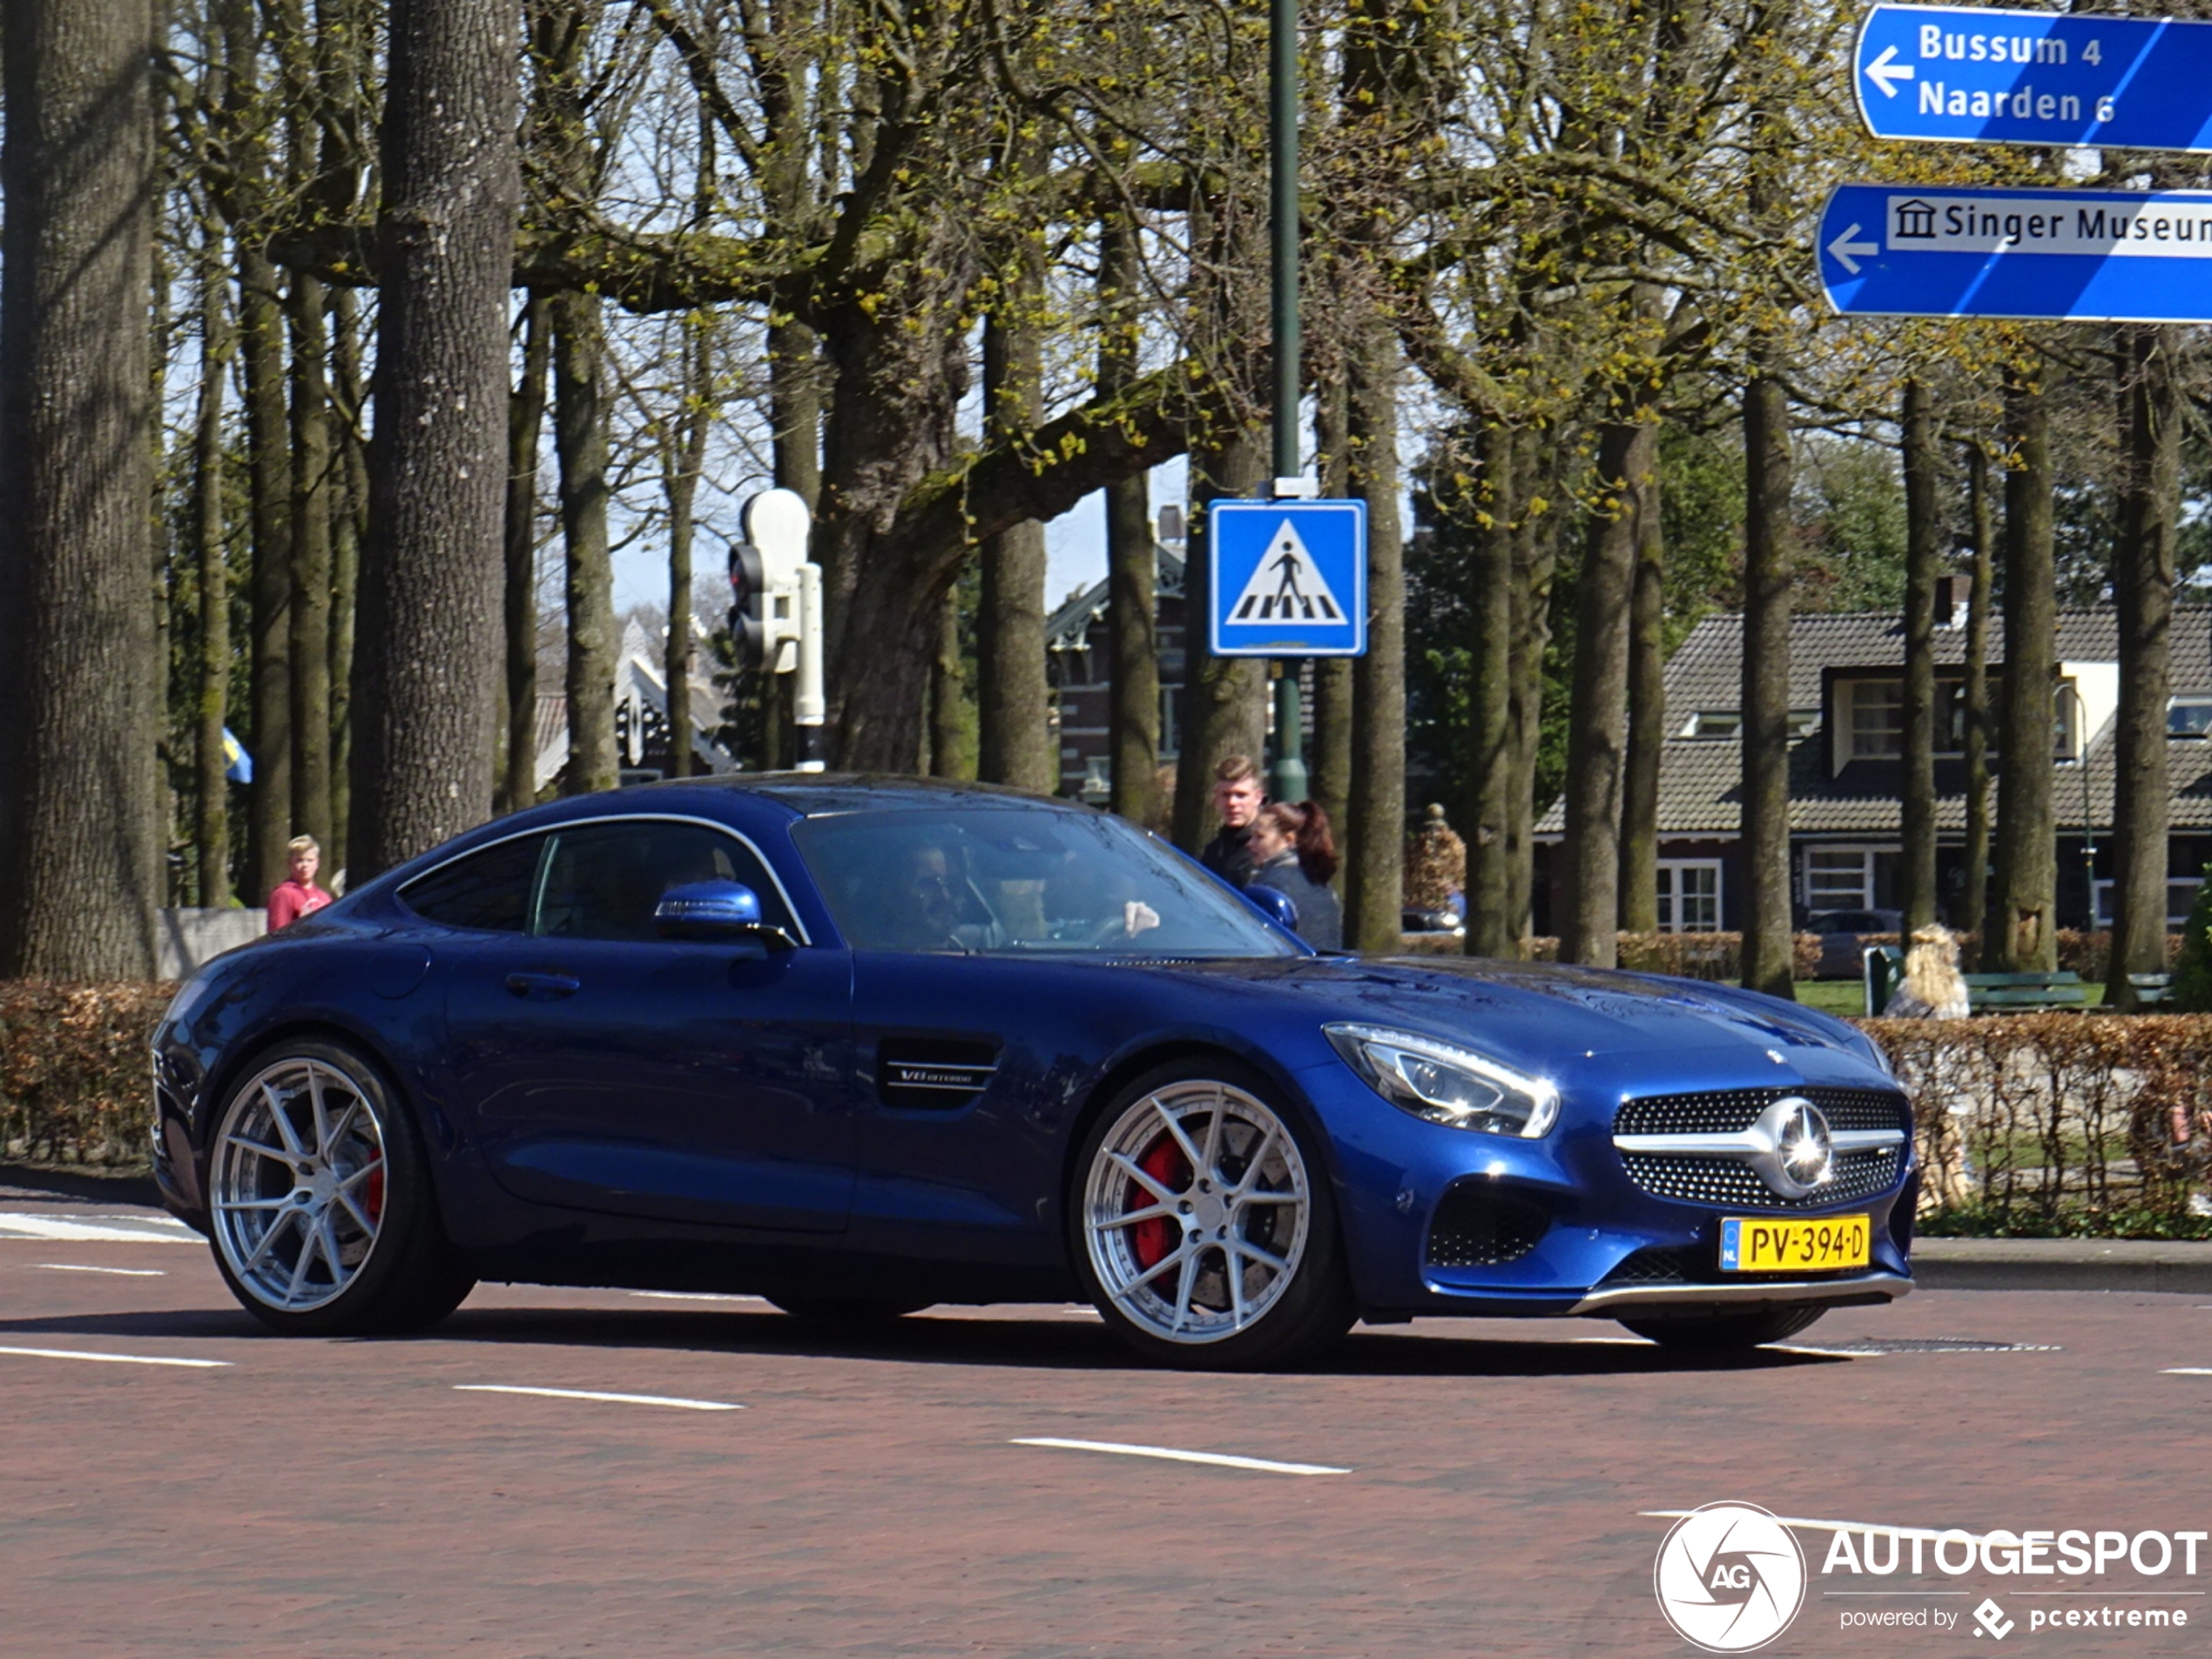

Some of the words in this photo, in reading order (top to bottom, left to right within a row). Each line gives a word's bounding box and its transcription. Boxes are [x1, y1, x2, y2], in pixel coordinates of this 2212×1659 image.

[1919, 24, 2067, 64] Bussum
[2081, 39, 2102, 66] 4
[1919, 81, 2080, 121] Naarden
[2095, 97, 2115, 123] 6
[1945, 205, 2064, 246] Singer
[1723, 1251, 1737, 1262] NL
[1751, 1224, 1863, 1263] PV-394-D
